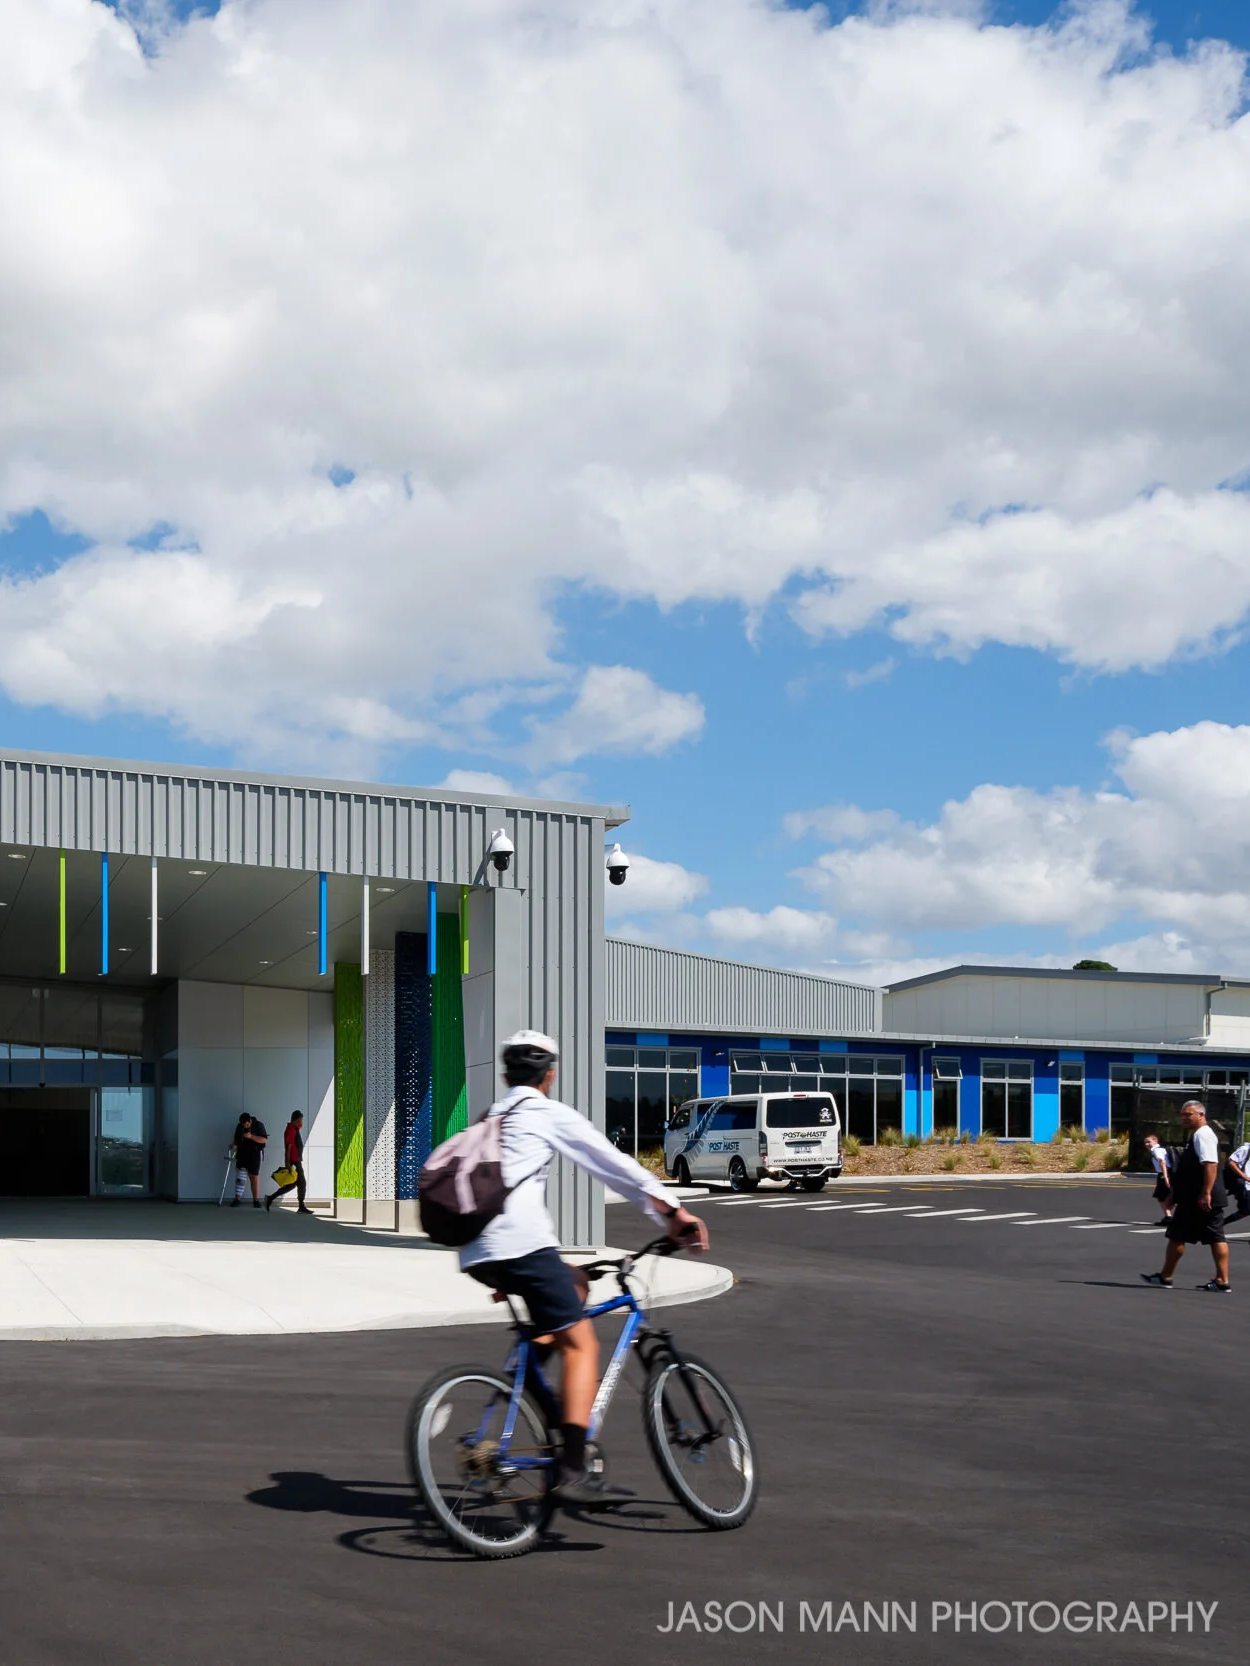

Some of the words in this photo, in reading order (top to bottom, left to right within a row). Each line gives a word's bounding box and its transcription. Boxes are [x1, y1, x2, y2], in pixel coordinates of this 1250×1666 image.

[782, 1131, 801, 1139] POST
[708, 1141, 723, 1152] POST
[723, 1141, 740, 1150] HASTE
